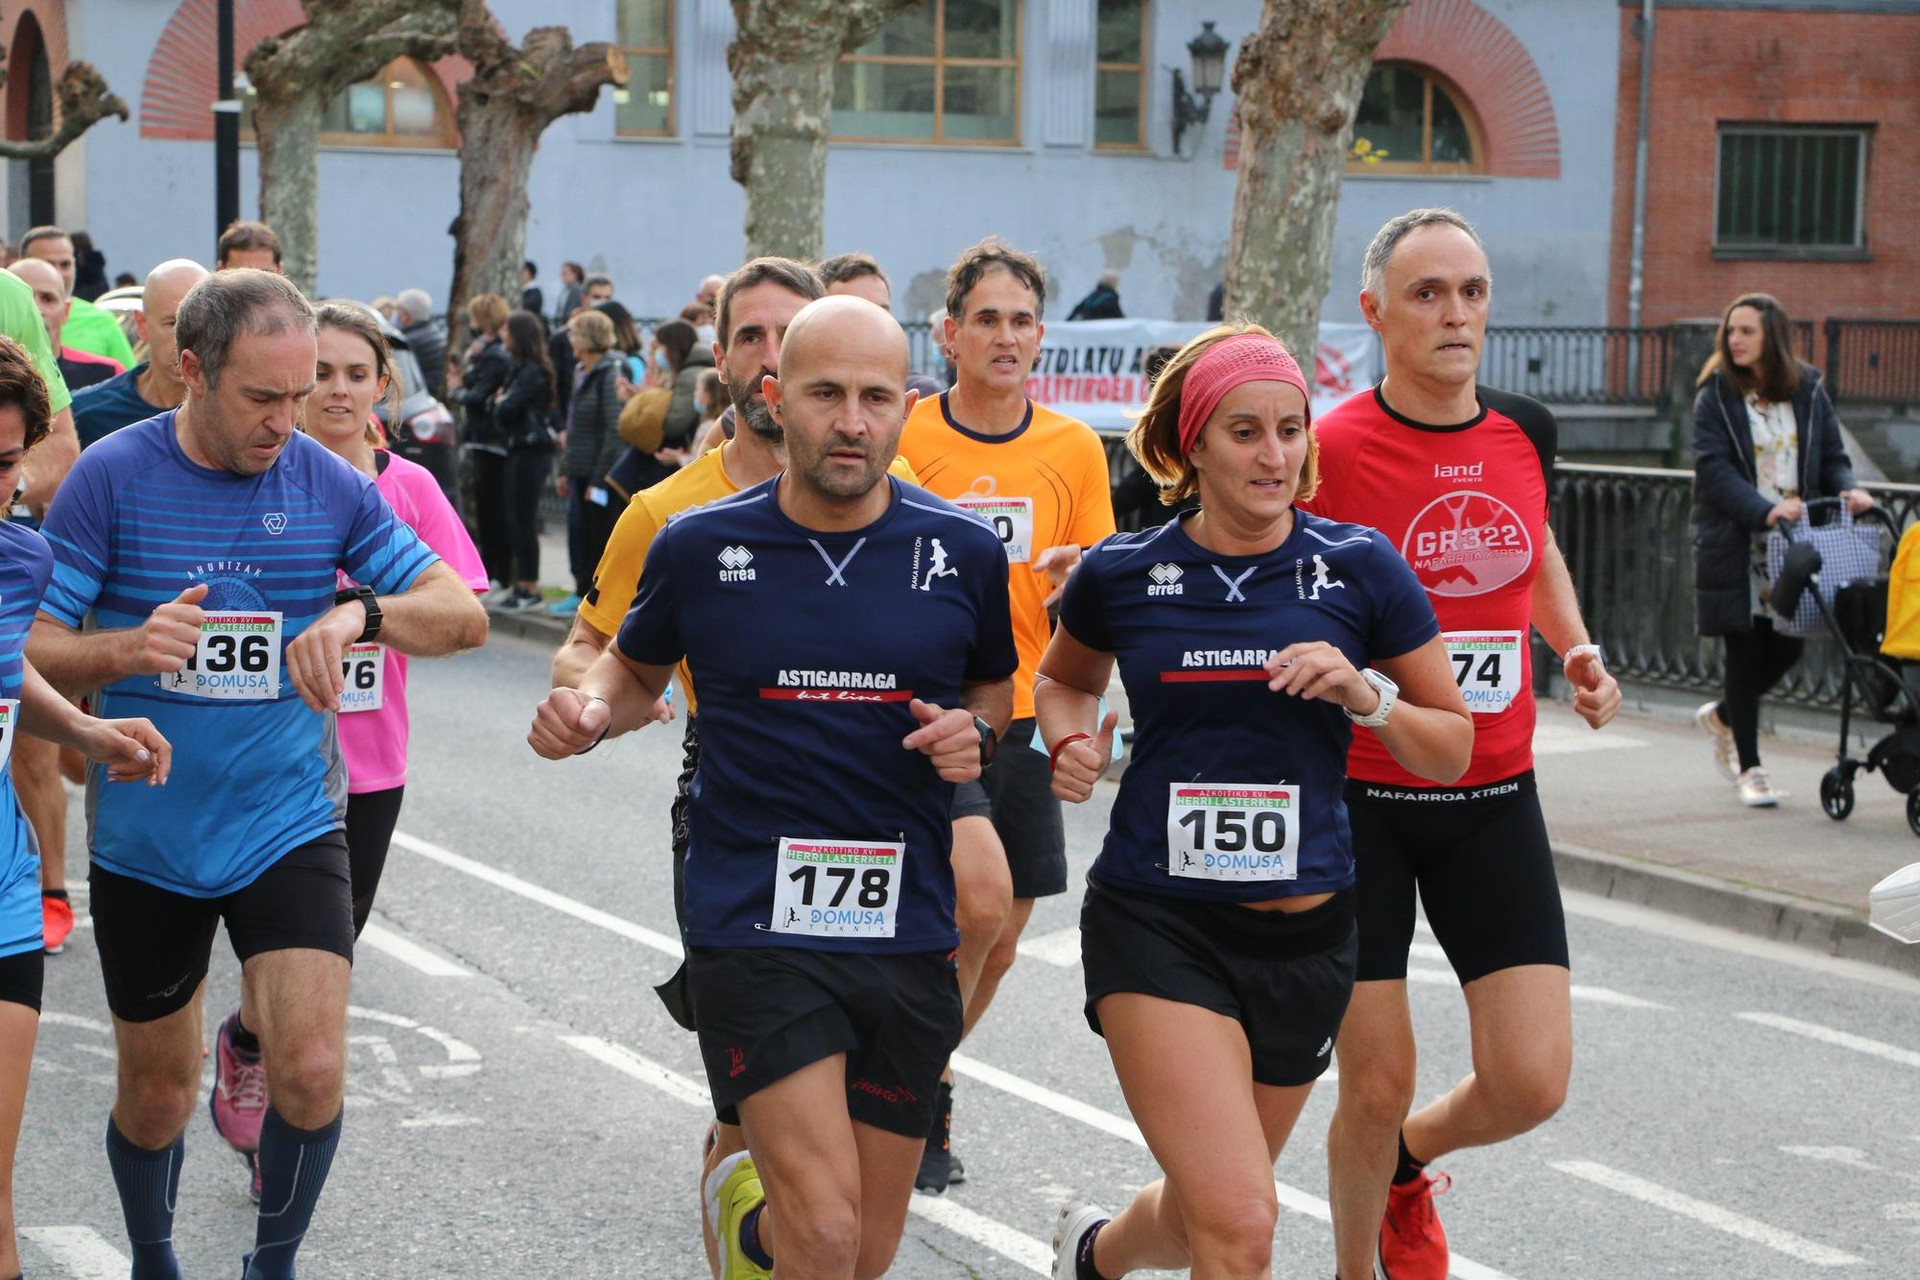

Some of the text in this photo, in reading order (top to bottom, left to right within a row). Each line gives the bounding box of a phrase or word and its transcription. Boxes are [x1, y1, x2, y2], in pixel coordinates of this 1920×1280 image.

[1434, 461, 1484, 479] land
[1416, 525, 1521, 557] GR322
[911, 537, 922, 590] RAKA MARATON
[1414, 552, 1483, 569] NAFARROA
[187, 561, 262, 580] AHUNTZAK
[206, 623, 273, 631] LASTERKETA
[1452, 654, 1501, 688] 74
[196, 675, 268, 687] DOMUSA
[778, 670, 896, 689] ASTIGARRAGA
[196, 686, 269, 694] TEKNIK
[1367, 782, 1519, 801] NAFARROA XTREM
[1177, 797, 1289, 807] HERRI LASTERKETA
[1179, 810, 1286, 852] 150
[787, 850, 895, 864] HERRI LASTERKETA
[811, 846, 859, 854] AZKOITIKO
[1204, 854, 1284, 869] DOMUSA
[1204, 867, 1285, 876] TEKNIK
[789, 865, 890, 908] 178
[811, 910, 884, 925] DOMUSA
[809, 924, 884, 932] TEKNIK
